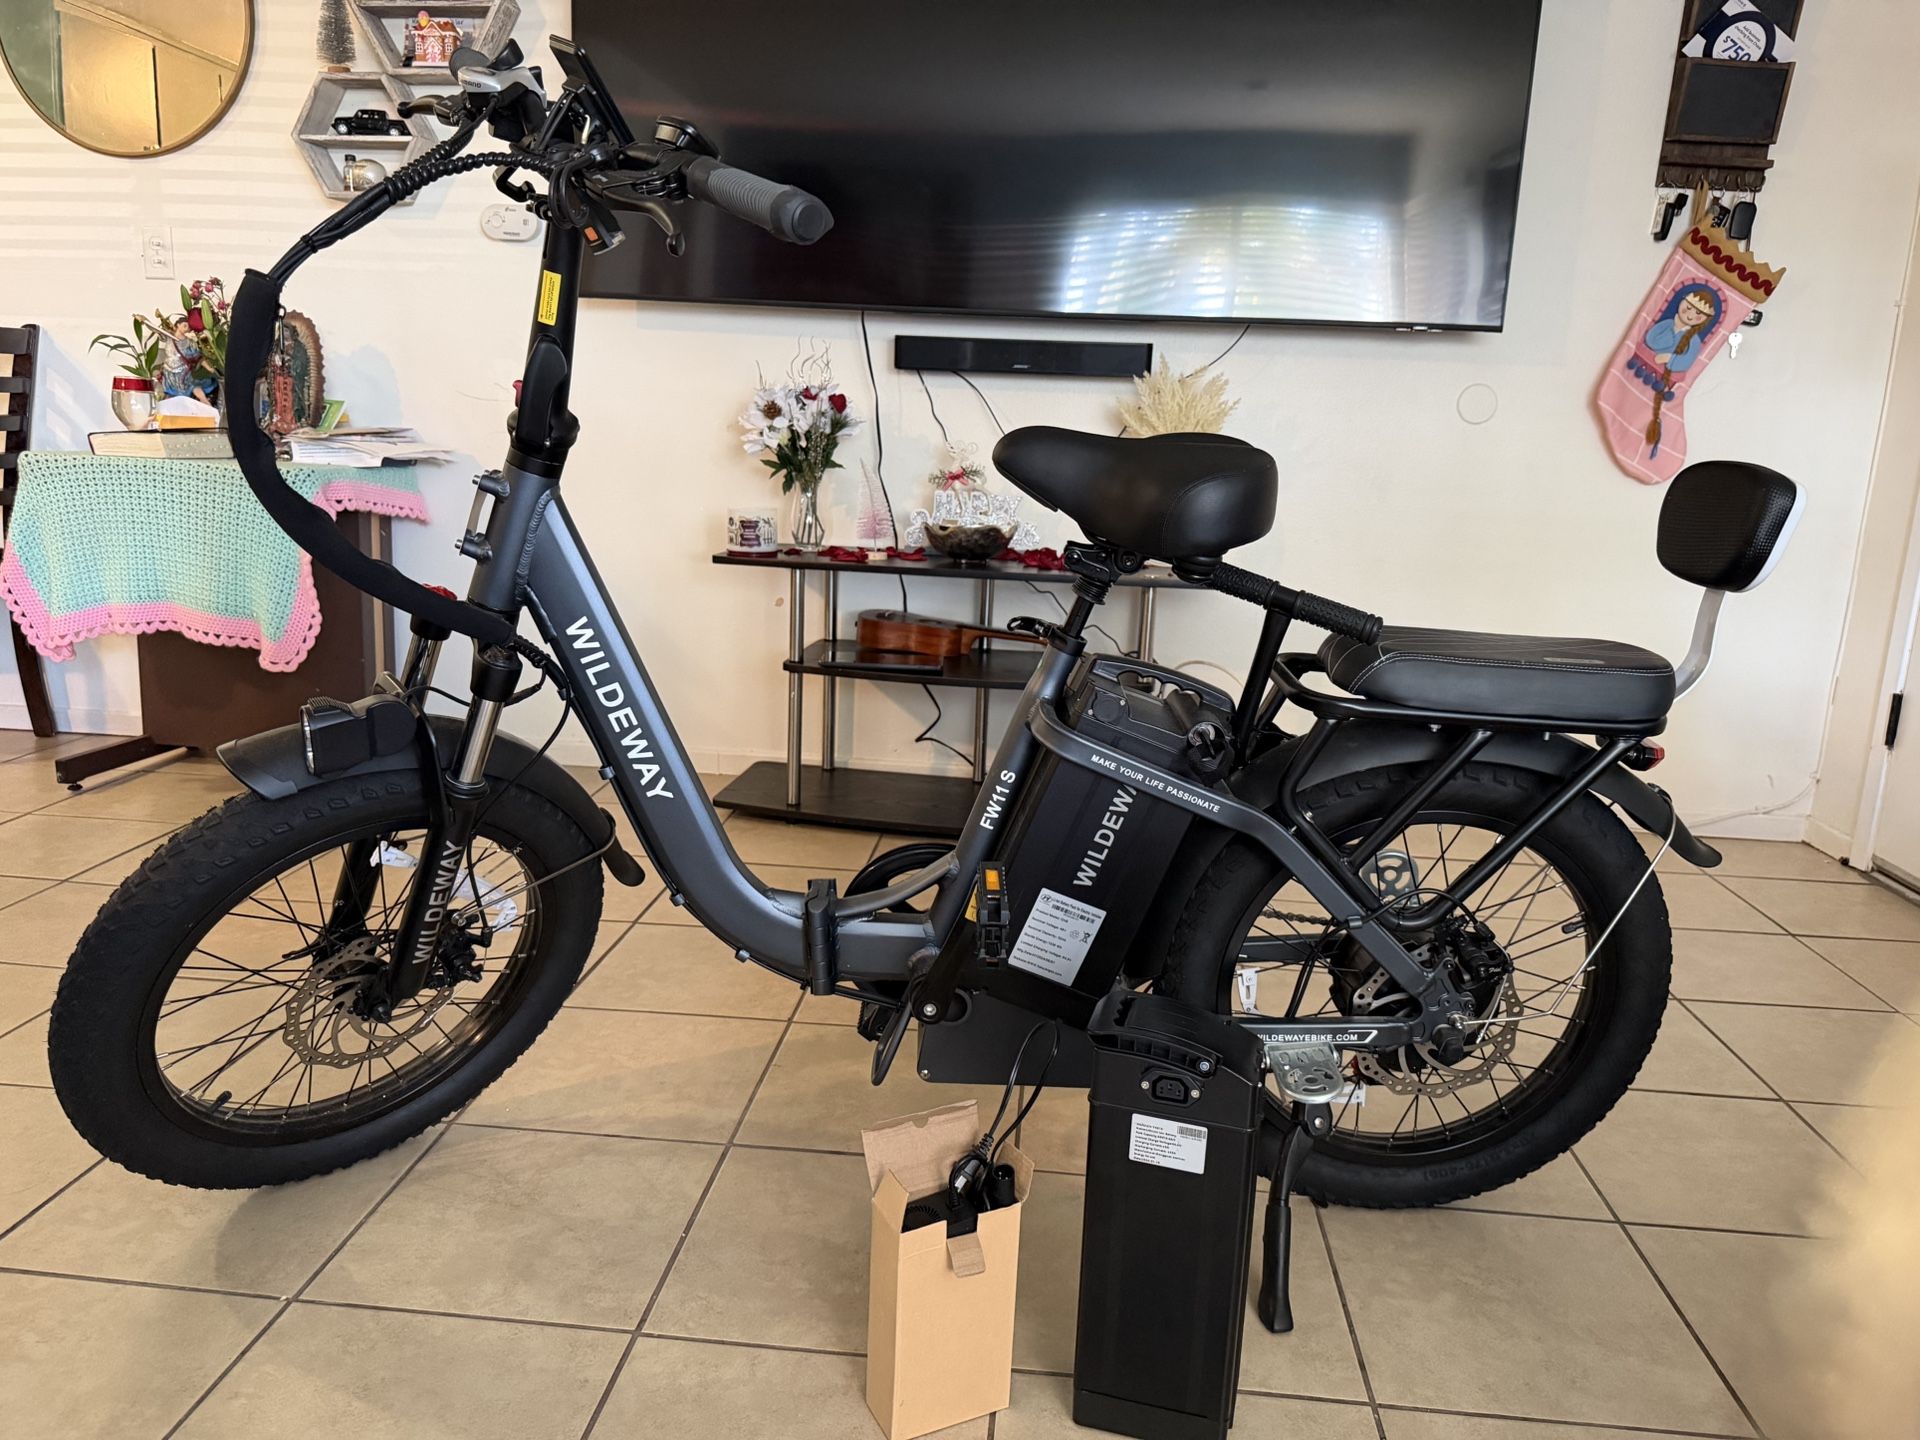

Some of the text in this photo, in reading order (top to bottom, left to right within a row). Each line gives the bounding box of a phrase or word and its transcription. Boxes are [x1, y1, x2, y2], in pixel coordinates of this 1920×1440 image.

[565, 616, 674, 799] WILDEWAY
[979, 769, 1017, 830] FW11 S
[1090, 754, 1221, 813] MAKE YOUR LIFE PASSIONATE
[1072, 784, 1137, 887] WILDEW
[412, 840, 464, 964] WILDEWAY
